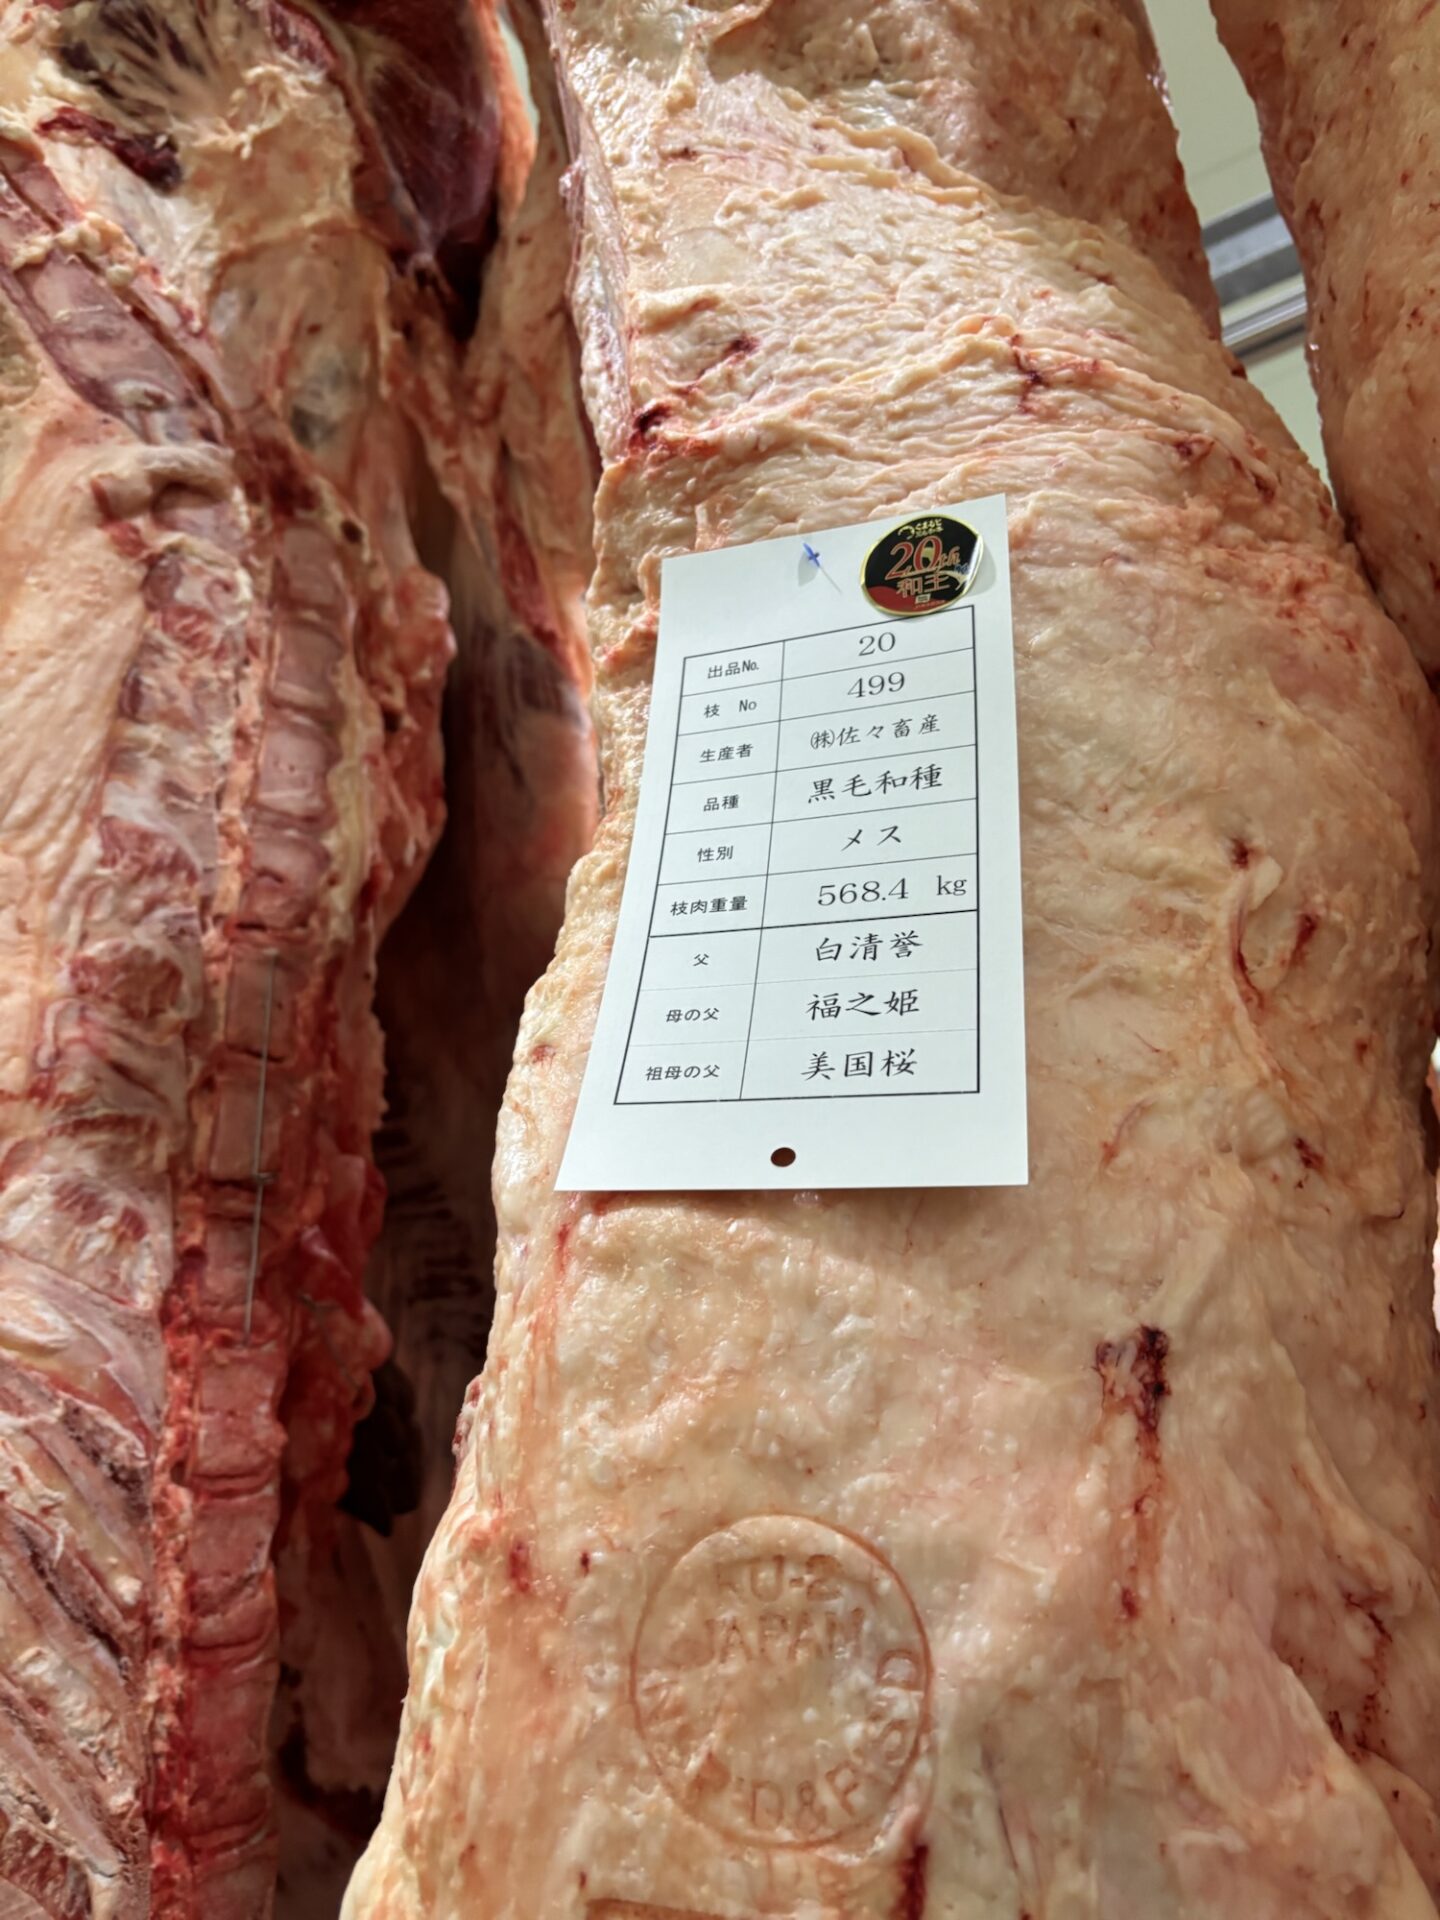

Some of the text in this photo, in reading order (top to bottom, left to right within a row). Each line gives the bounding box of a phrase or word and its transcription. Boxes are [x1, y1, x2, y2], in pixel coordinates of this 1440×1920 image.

[857, 631, 897, 657] 20
[847, 671, 907, 699] 499
[703, 698, 758, 719] 枝 No
[698, 743, 754, 764] 生産者
[807, 762, 944, 805] 黒毛和種
[702, 793, 740, 813] 品種
[841, 824, 902, 852] メス
[696, 845, 734, 863] 性別
[817, 874, 968, 907] 568.4 kg
[669, 895, 748, 917] 枝肉重量
[815, 928, 924, 963] 白清誉
[692, 953, 710, 967] 父
[665, 1007, 720, 1024] 母の父
[805, 988, 920, 1022] 福之姫
[644, 1064, 721, 1082] 祖母の父
[800, 1047, 918, 1081] 美国桜
[698, 1607, 865, 1665] JAPAN
